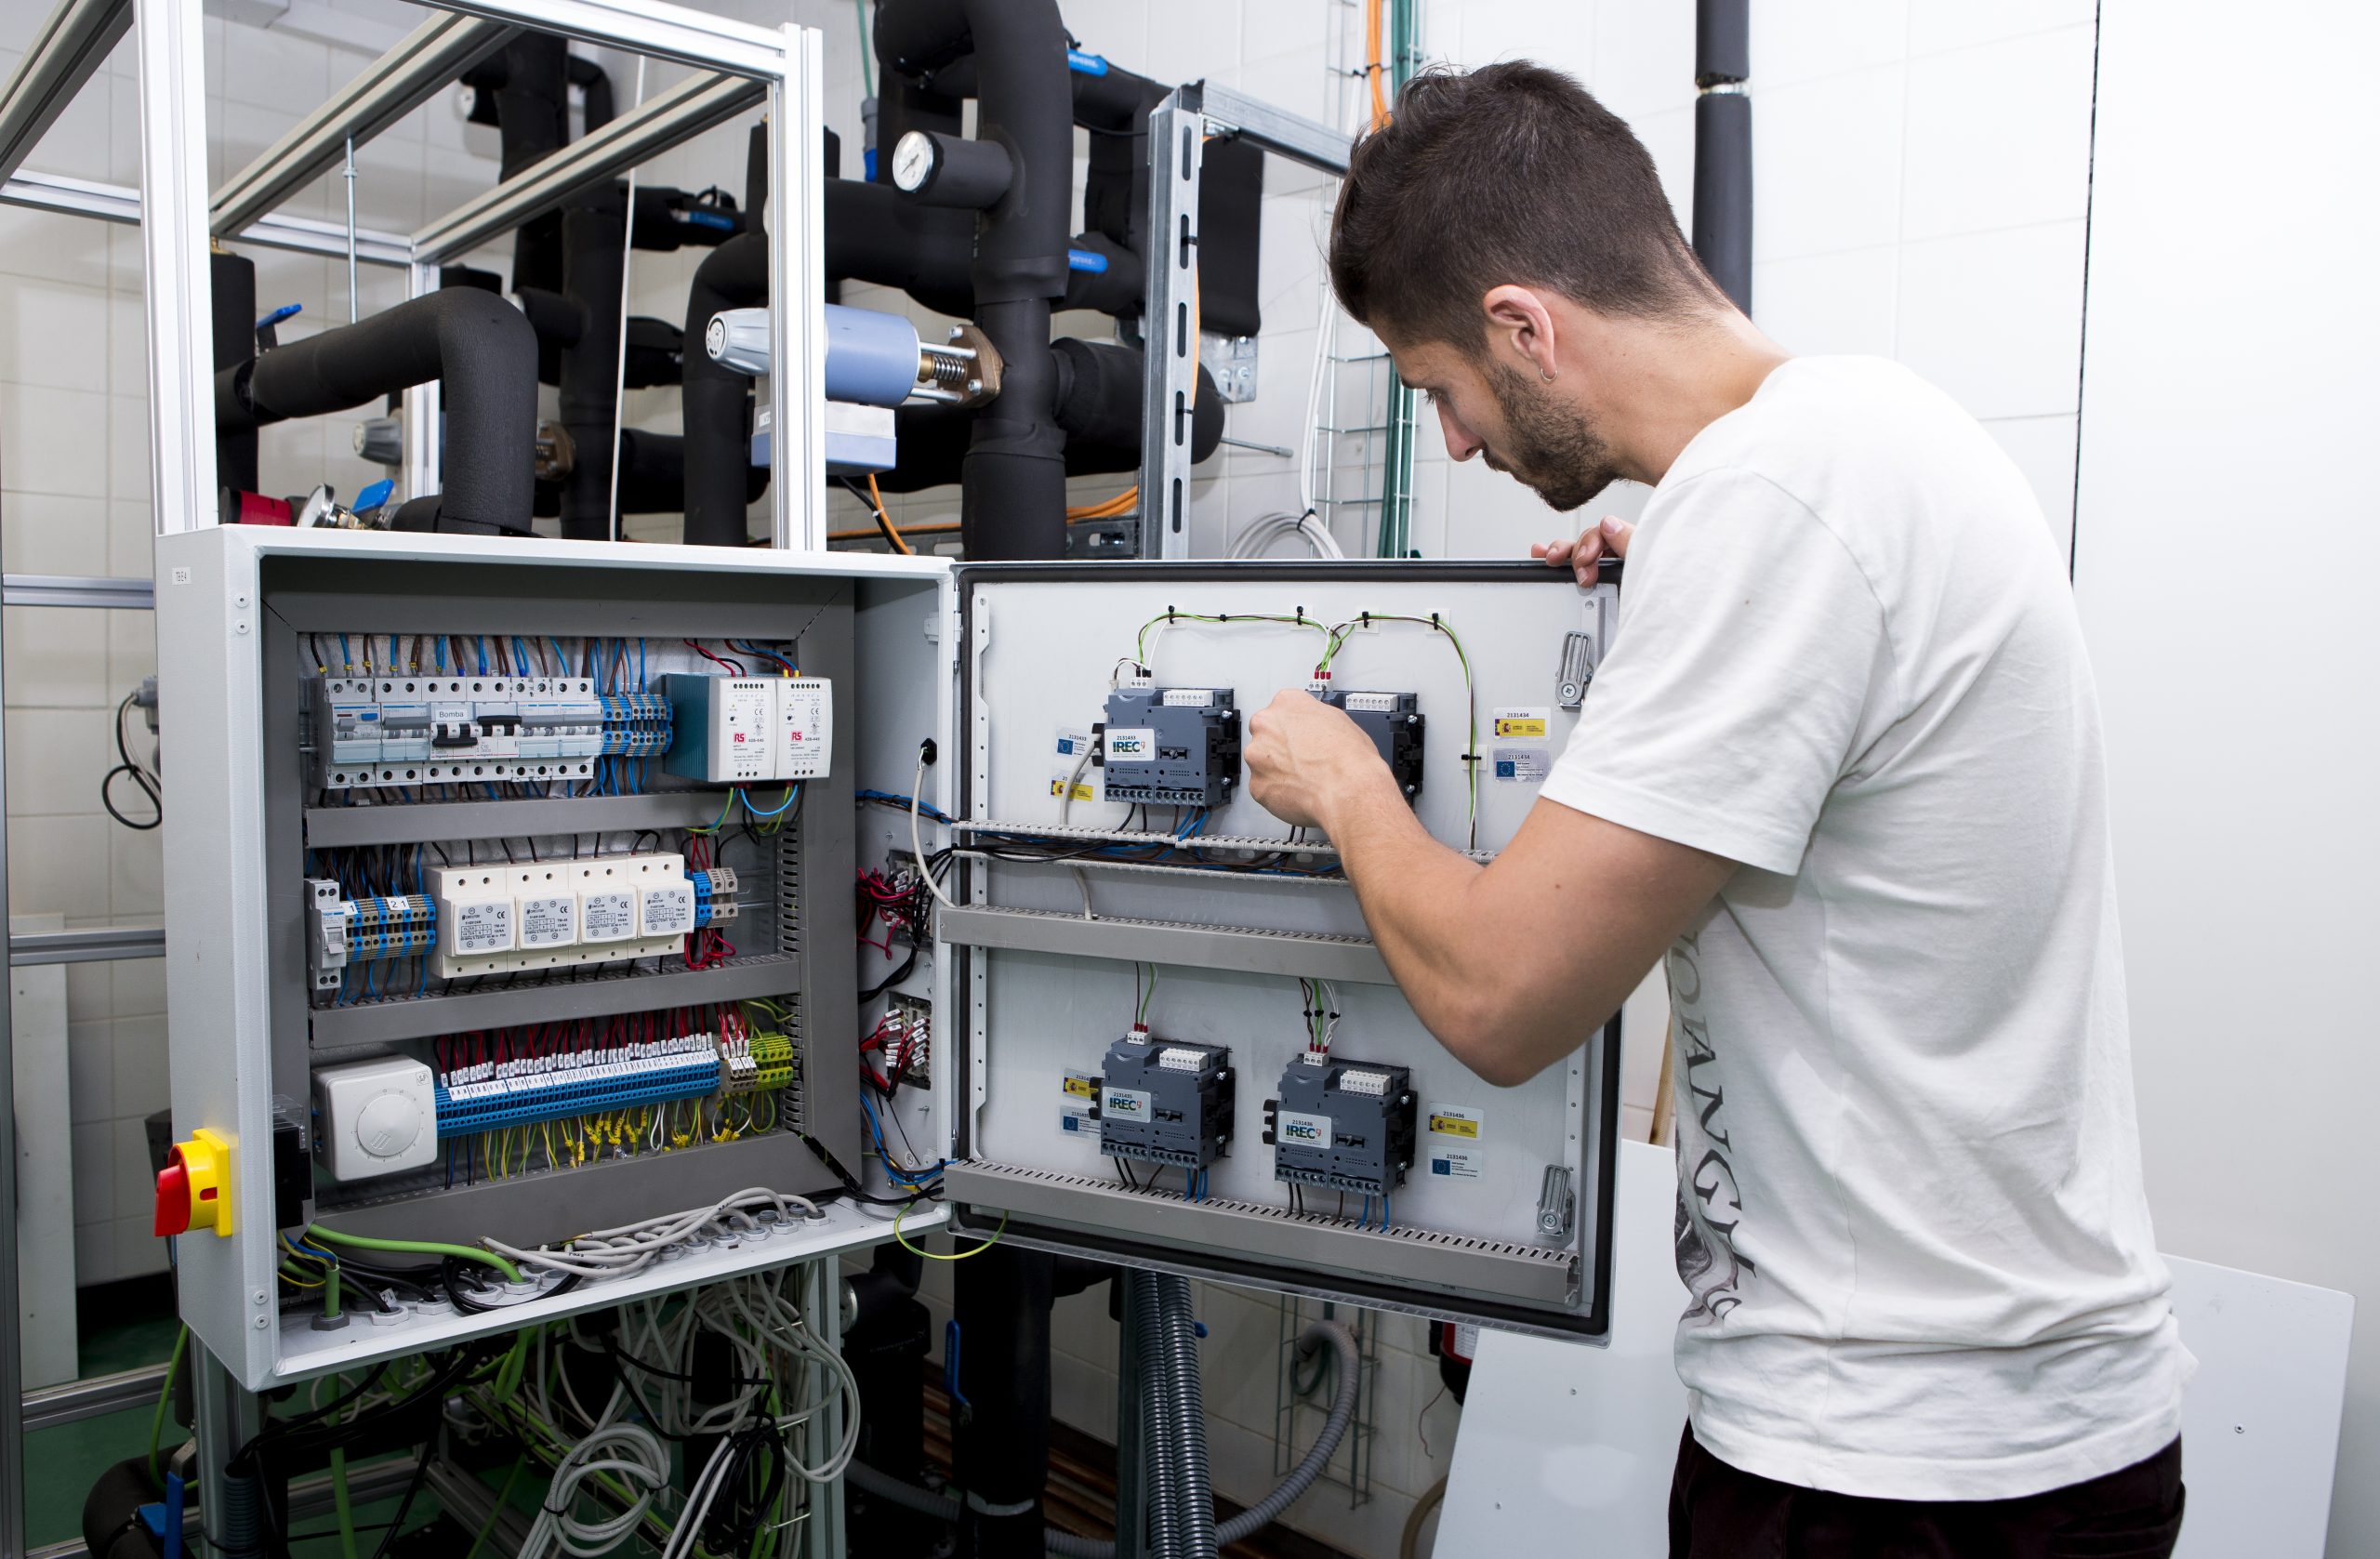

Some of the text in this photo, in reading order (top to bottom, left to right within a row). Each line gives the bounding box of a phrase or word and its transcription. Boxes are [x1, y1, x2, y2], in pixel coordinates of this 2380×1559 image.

[439, 710, 464, 719] Bomba
[734, 733, 745, 743] RS
[791, 732, 801, 741] RS
[1113, 741, 1140, 753] IREC
[1109, 1097, 1136, 1111] IREC
[1286, 1124, 1316, 1139] IREC
